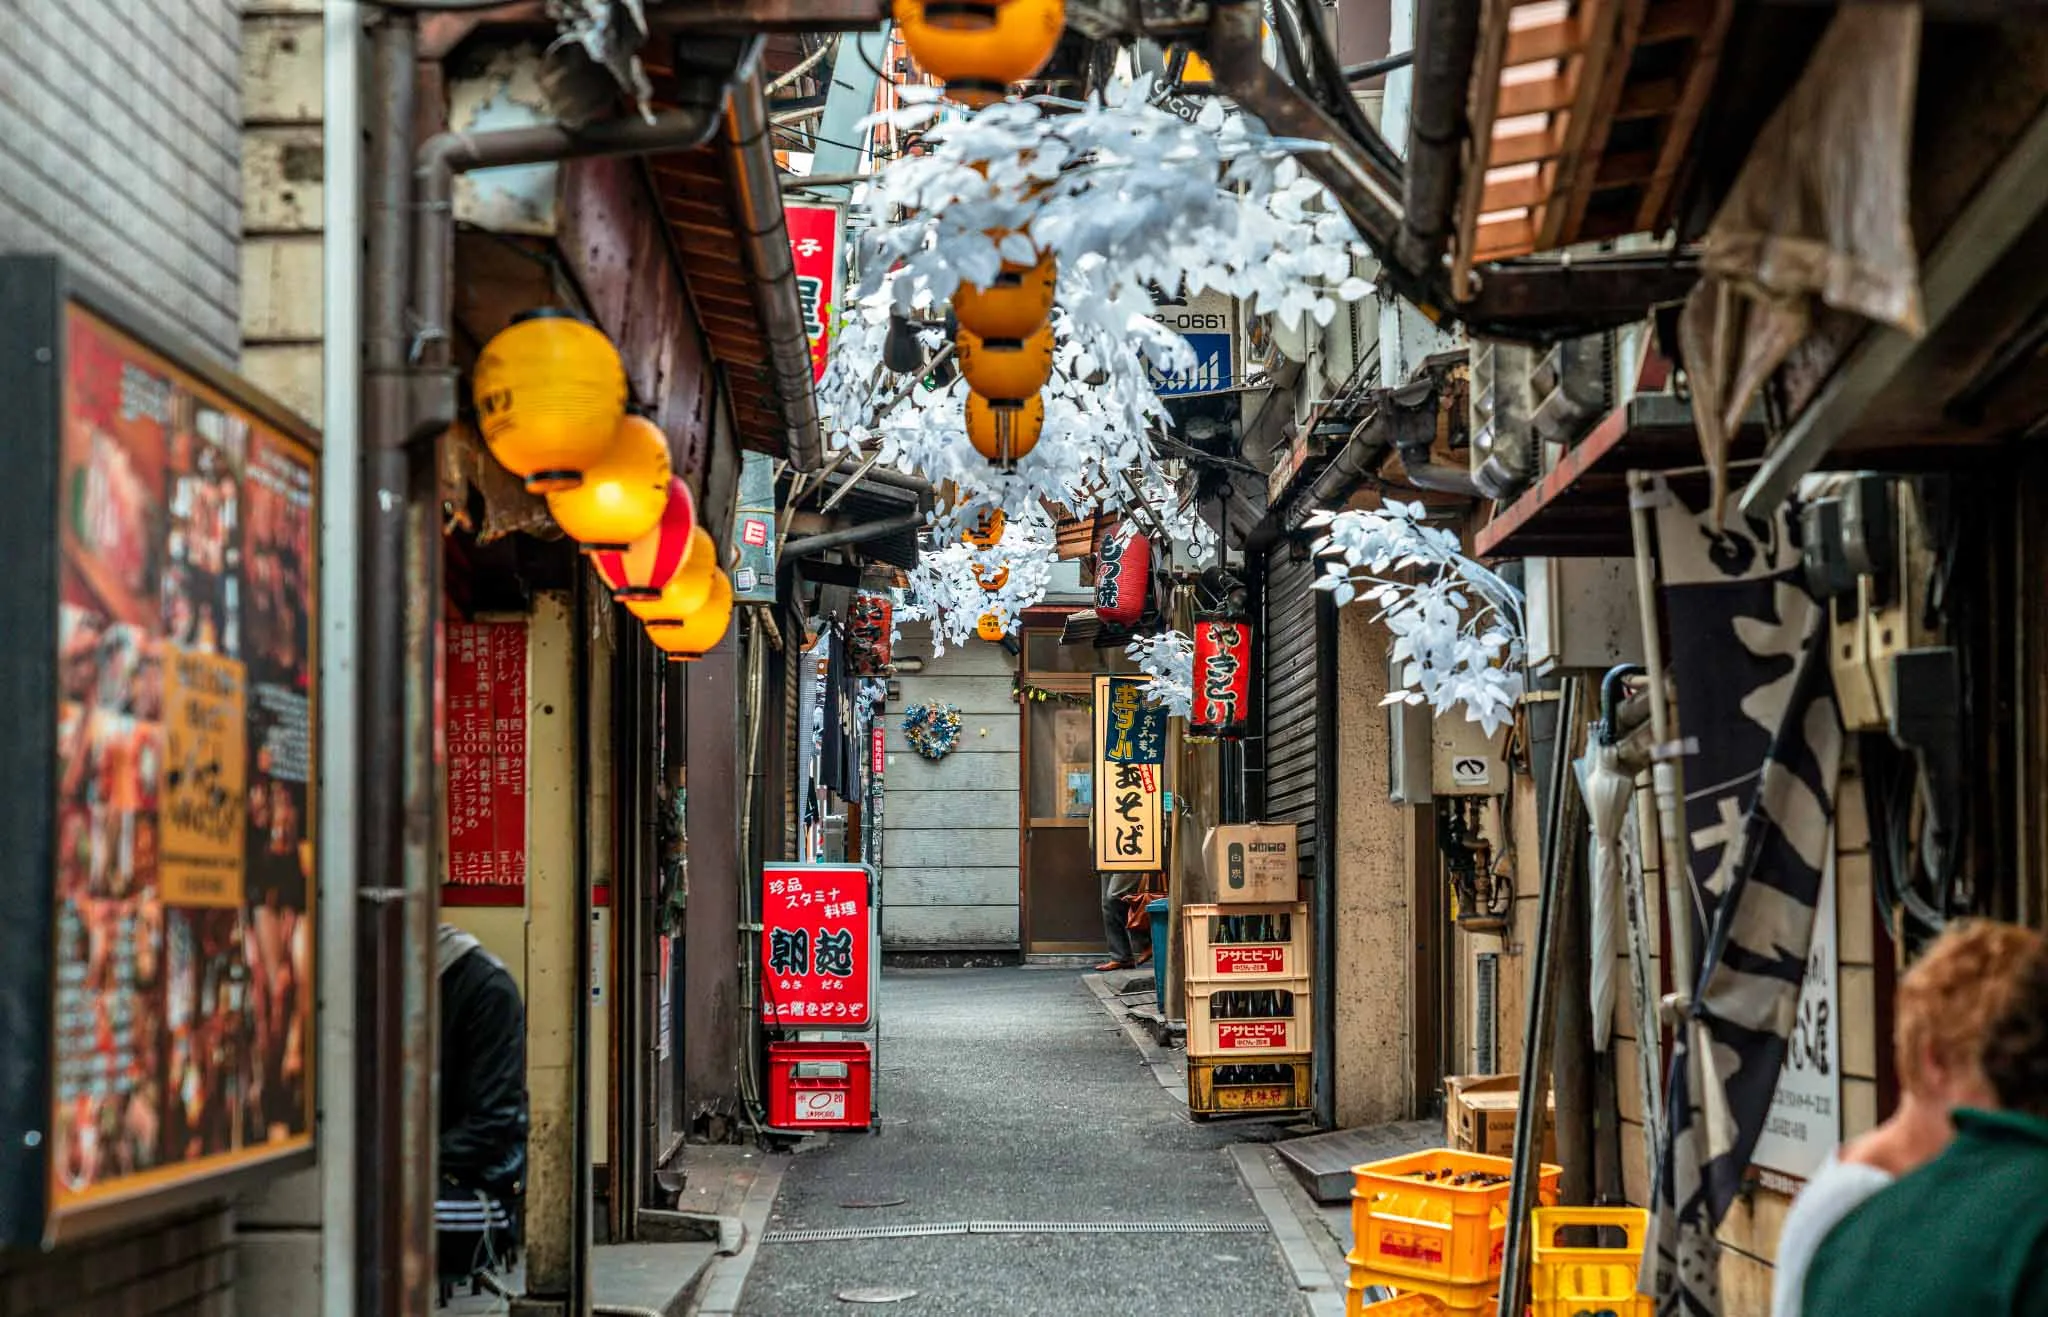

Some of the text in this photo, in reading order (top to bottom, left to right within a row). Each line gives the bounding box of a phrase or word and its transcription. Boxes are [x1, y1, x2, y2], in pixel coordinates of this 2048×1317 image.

[789, 238, 823, 257] 子
[1097, 533, 1124, 608] もつ焼
[1205, 622, 1241, 727] やきとり
[769, 877, 803, 895] 珍品
[785, 887, 841, 909] スタミナ
[823, 901, 857, 919] 料理
[769, 926, 854, 977] 朝起
[1217, 950, 1282, 962] アサヒビール
[1220, 1024, 1285, 1037] アサヒビール
